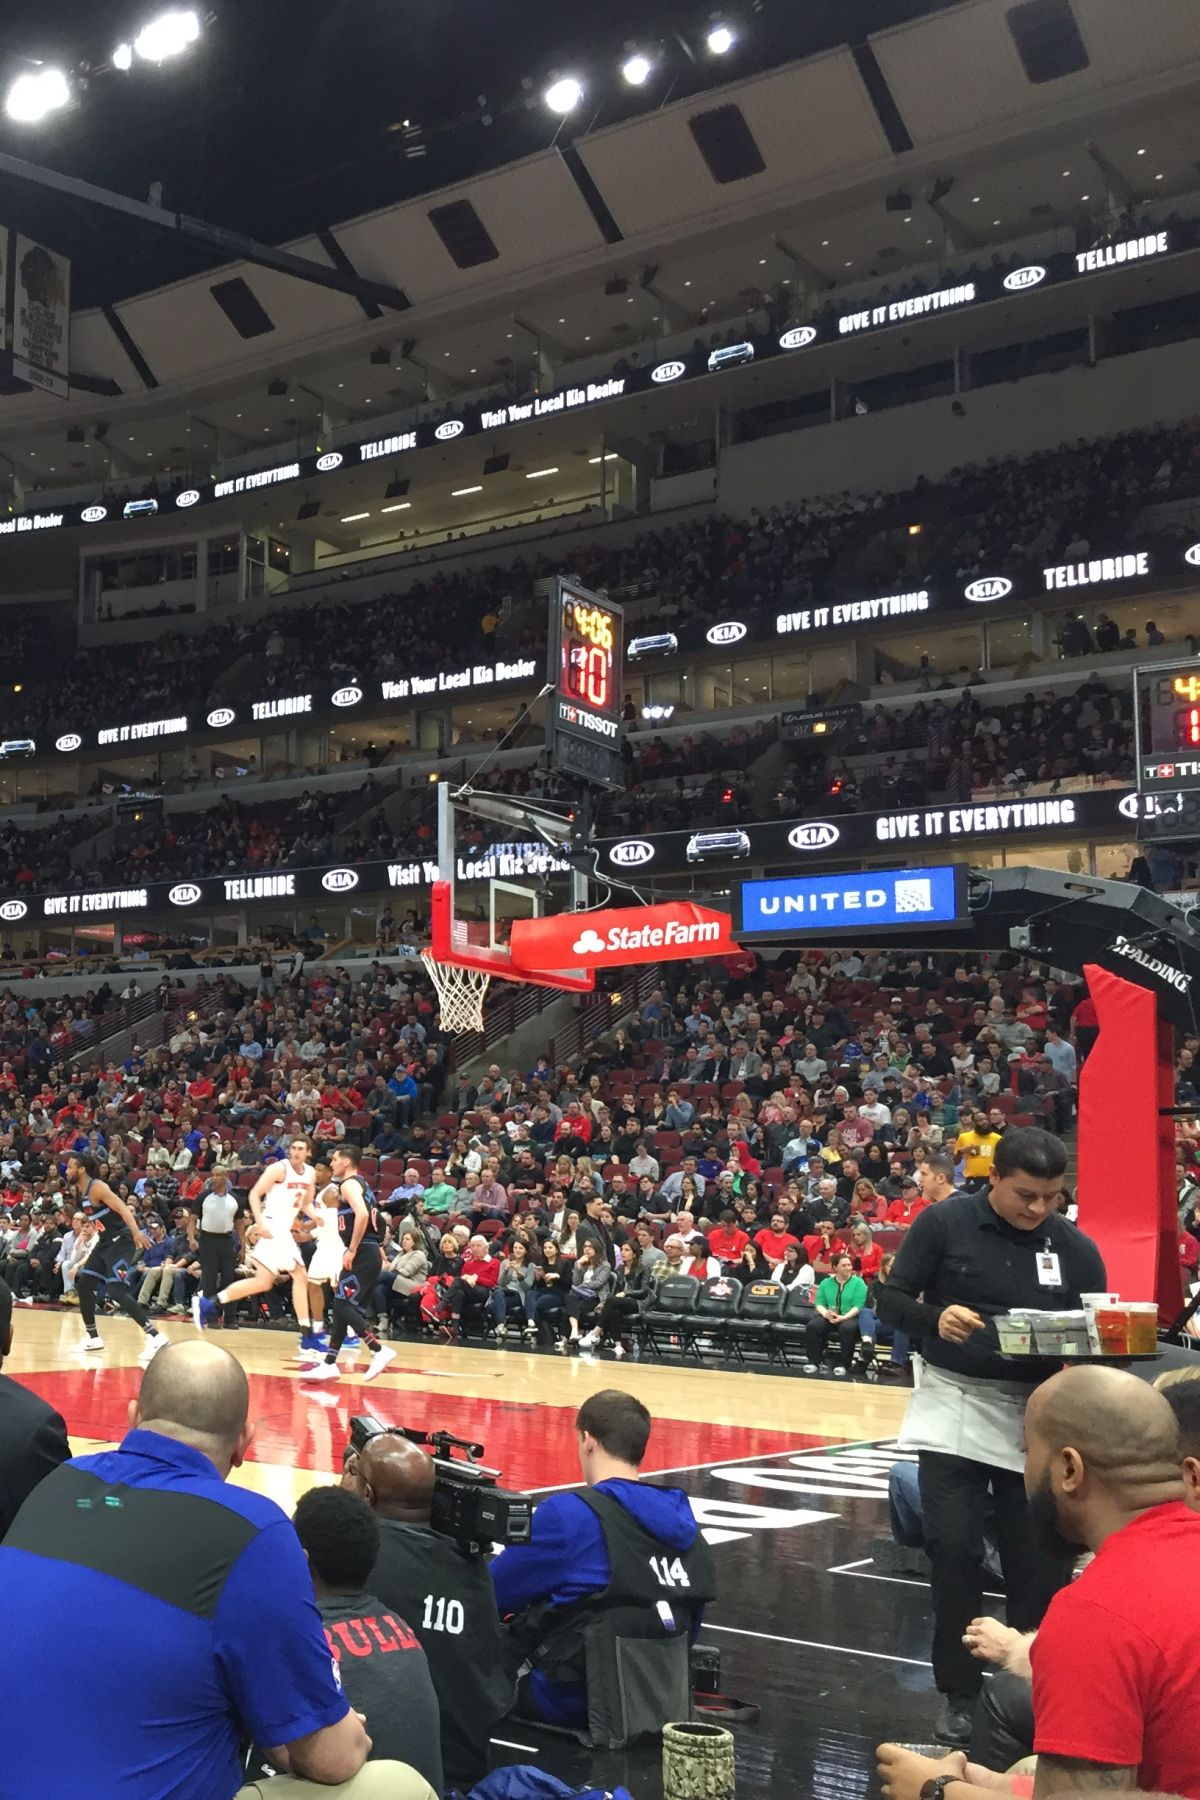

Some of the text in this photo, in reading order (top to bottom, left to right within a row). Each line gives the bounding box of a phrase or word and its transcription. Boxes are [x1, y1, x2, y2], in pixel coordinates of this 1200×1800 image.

[1076, 232, 1167, 272] TELLURIDE
[839, 283, 975, 333] GIVE IT EVERYTHING
[481, 379, 625, 428] Visit Your Local Kia Dealer
[360, 432, 416, 460] TELLURIDE
[215, 463, 299, 497] GIVE IT EVERYTHING
[18, 517, 32, 531] Kia
[34, 513, 63, 529] Dealer
[1044, 553, 1148, 589] TELLURIDE
[574, 605, 614, 650] 4:06
[777, 591, 928, 633] GIVE IT EVERYTHING
[382, 659, 536, 699] Visit Your Local Kia Dealer
[252, 695, 311, 720] TELLURIDE
[576, 709, 619, 738] TISSOT
[98, 717, 187, 744] GIVE IT EVERYTHING
[877, 800, 1075, 840] GIVE IT EVERYTHING
[388, 864, 420, 886] Visit
[423, 856, 496, 884] Yo Local
[44, 889, 147, 914] GIVE IT EVERYTHING
[224, 875, 295, 900] TELLURIDE
[760, 889, 887, 915] UNITED
[1112, 935, 1193, 993] SPALDING
[649, 1556, 690, 1587] 114
[422, 1595, 465, 1635] 110
